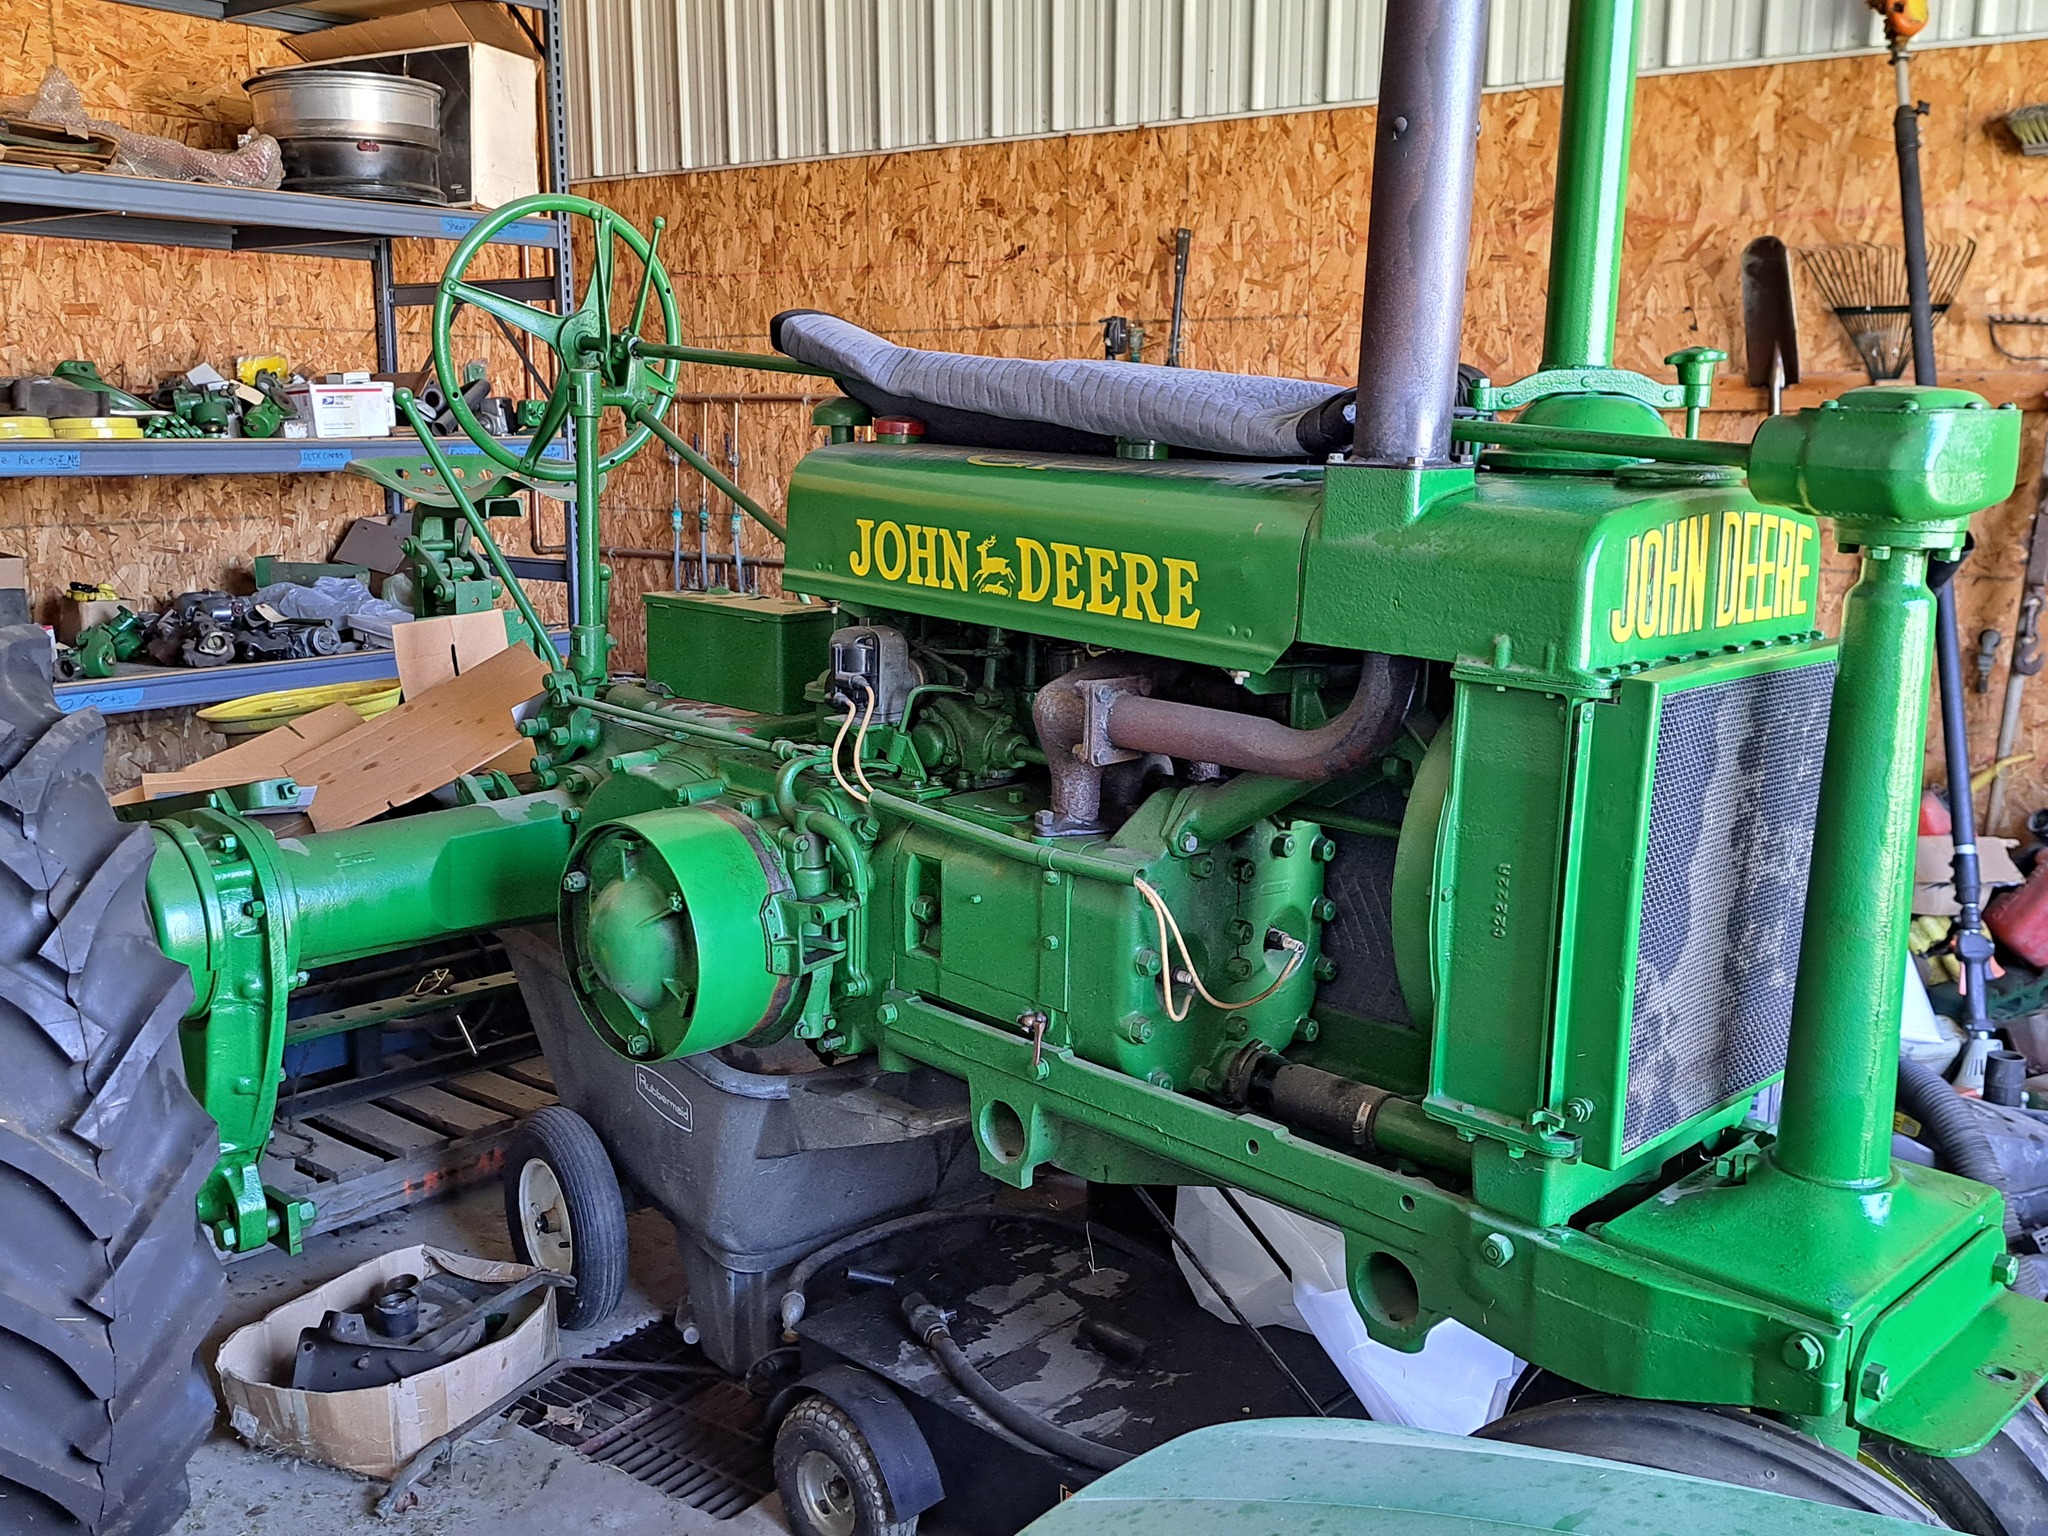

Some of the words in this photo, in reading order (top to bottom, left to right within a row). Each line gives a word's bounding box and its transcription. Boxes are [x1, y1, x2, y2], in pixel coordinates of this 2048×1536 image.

[849, 518, 971, 592] JOHN
[1015, 536, 1201, 630] DEERE
[1609, 513, 1710, 644] JOHN
[1714, 510, 1813, 630] DEERE
[638, 1072, 690, 1121] Rubbermaid
